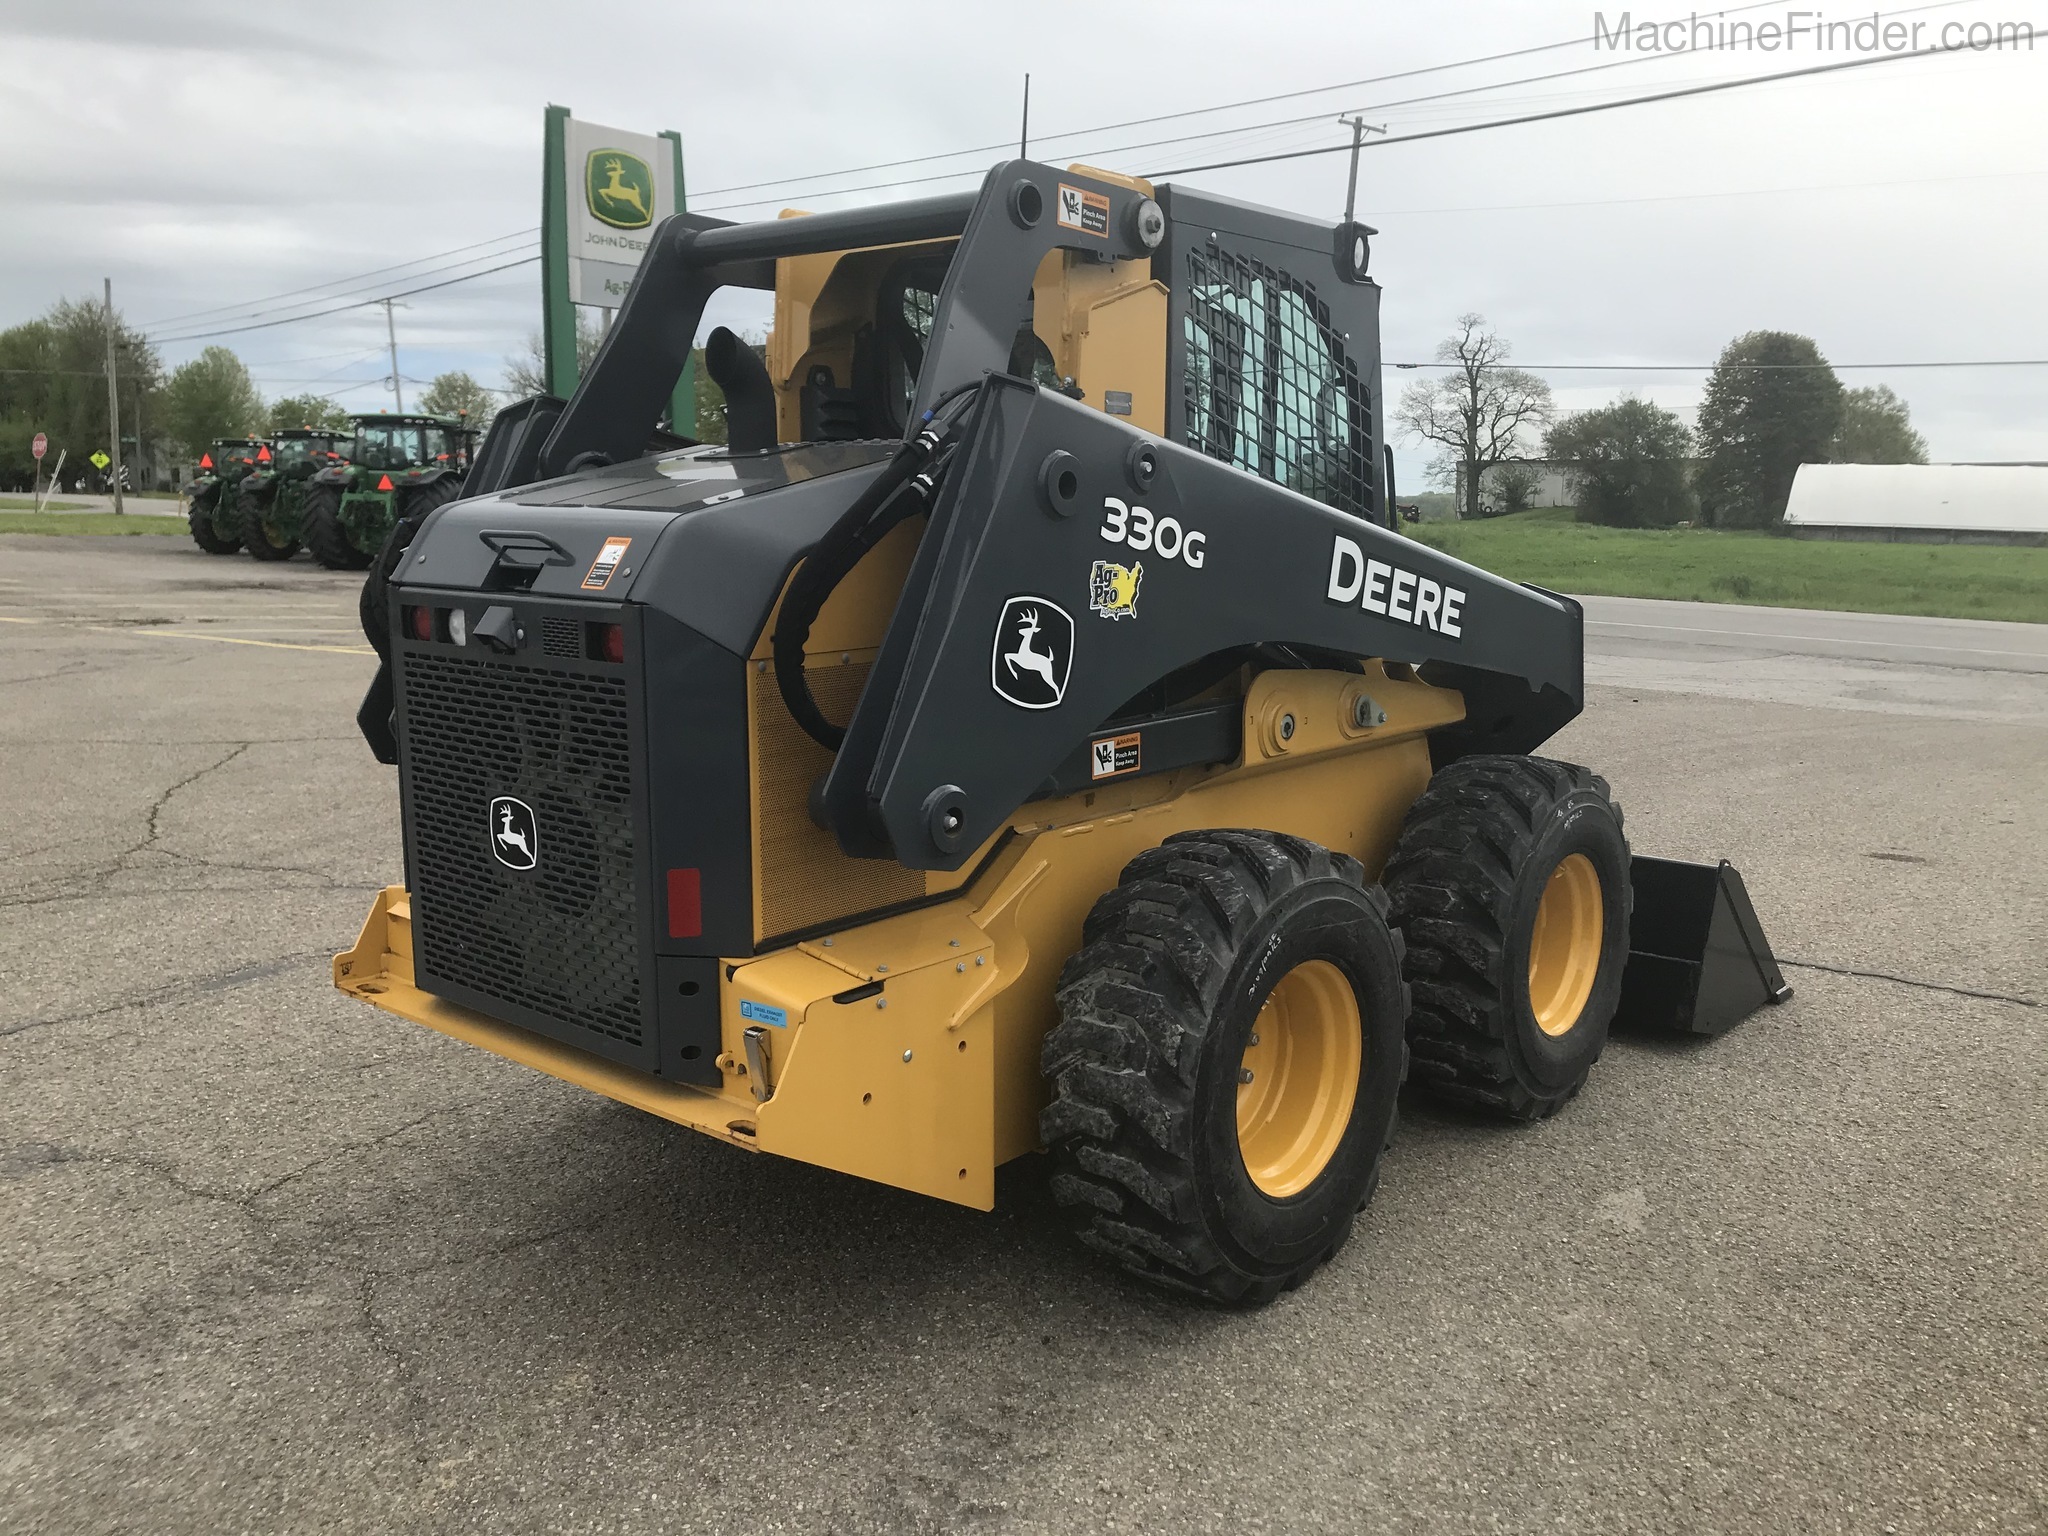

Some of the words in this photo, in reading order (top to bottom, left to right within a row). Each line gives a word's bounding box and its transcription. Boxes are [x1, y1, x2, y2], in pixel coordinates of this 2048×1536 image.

[1083, 208, 1096, 219] Pinch
[1096, 212, 1106, 221] Area
[585, 232, 617, 247] JOHN
[619, 236, 650, 251] DEER
[604, 278, 632, 296] Ag-P
[1100, 497, 1206, 569] 330G
[1092, 585, 1118, 606] Pro
[1327, 535, 1466, 638] DEERE
[1115, 751, 1127, 759] Pinch
